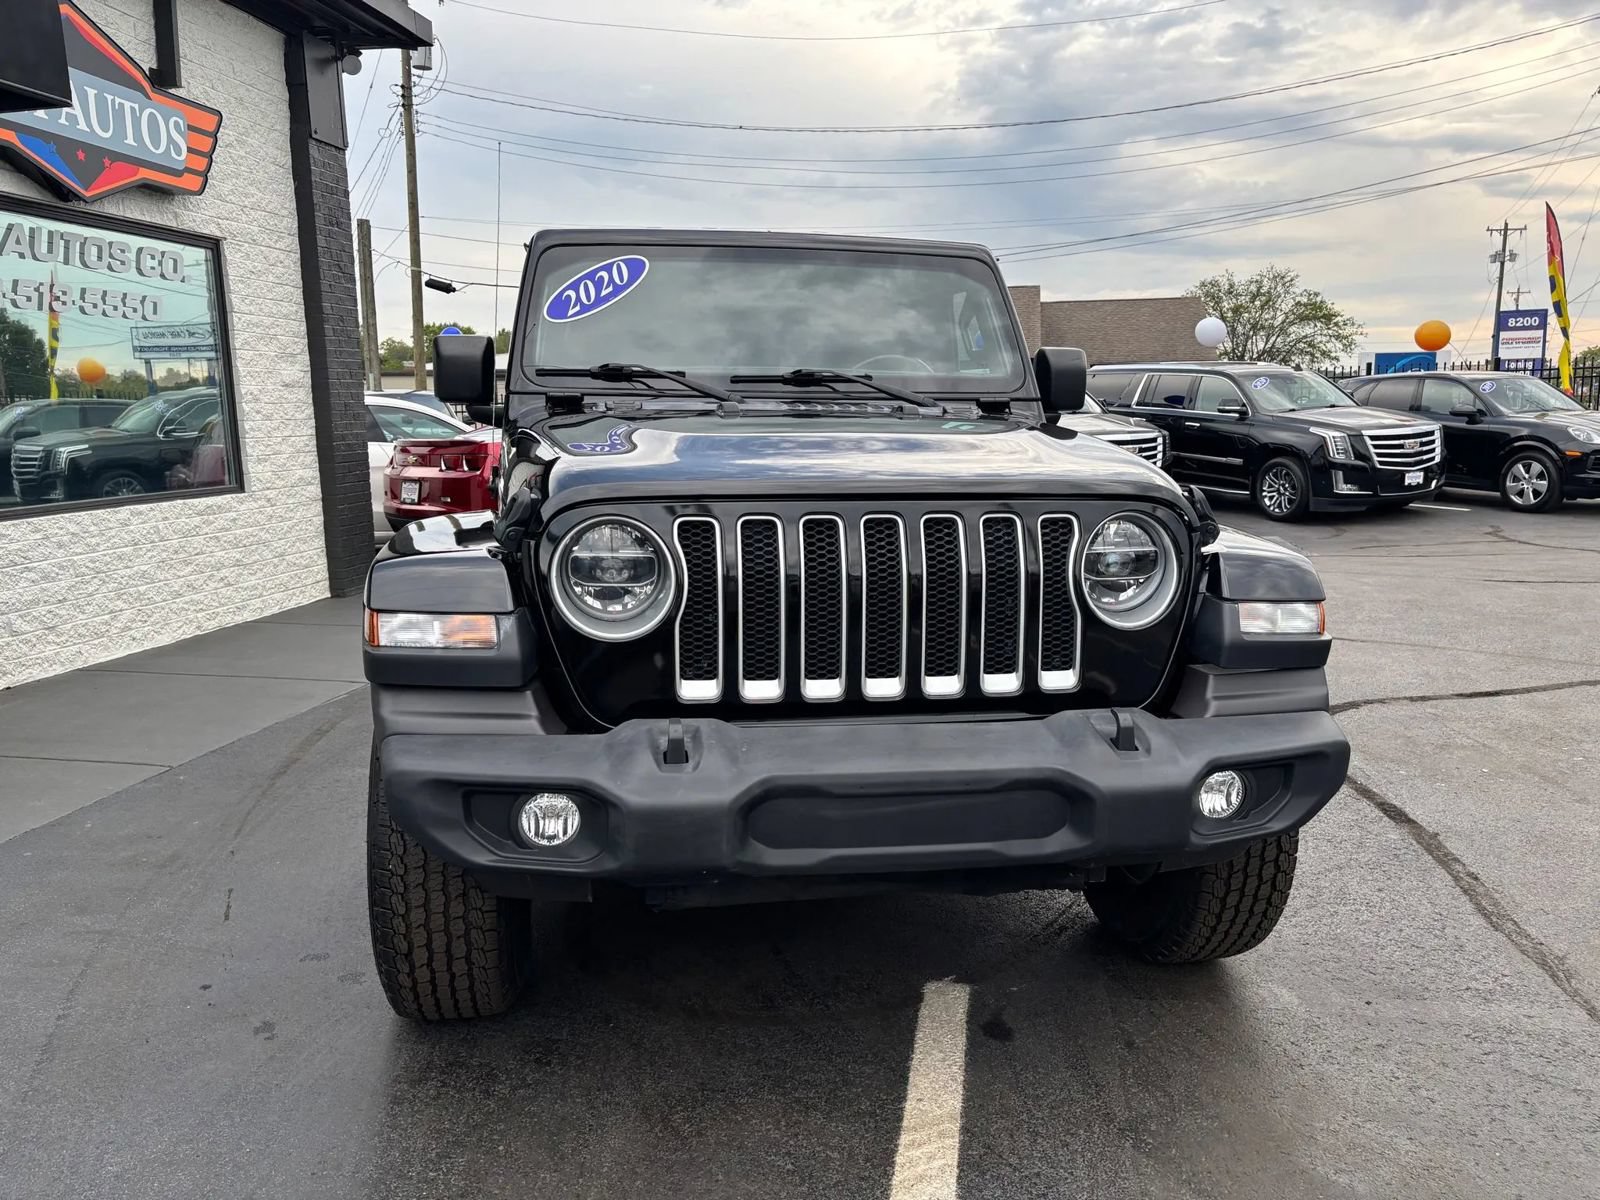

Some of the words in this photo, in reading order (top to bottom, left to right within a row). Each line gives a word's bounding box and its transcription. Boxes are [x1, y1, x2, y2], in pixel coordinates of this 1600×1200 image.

[58, 80, 188, 161] AUTOS
[0, 222, 132, 273] AUTOS
[135, 246, 192, 284] CO.
[562, 261, 628, 317] 2020
[1508, 317, 1539, 327] 8200
